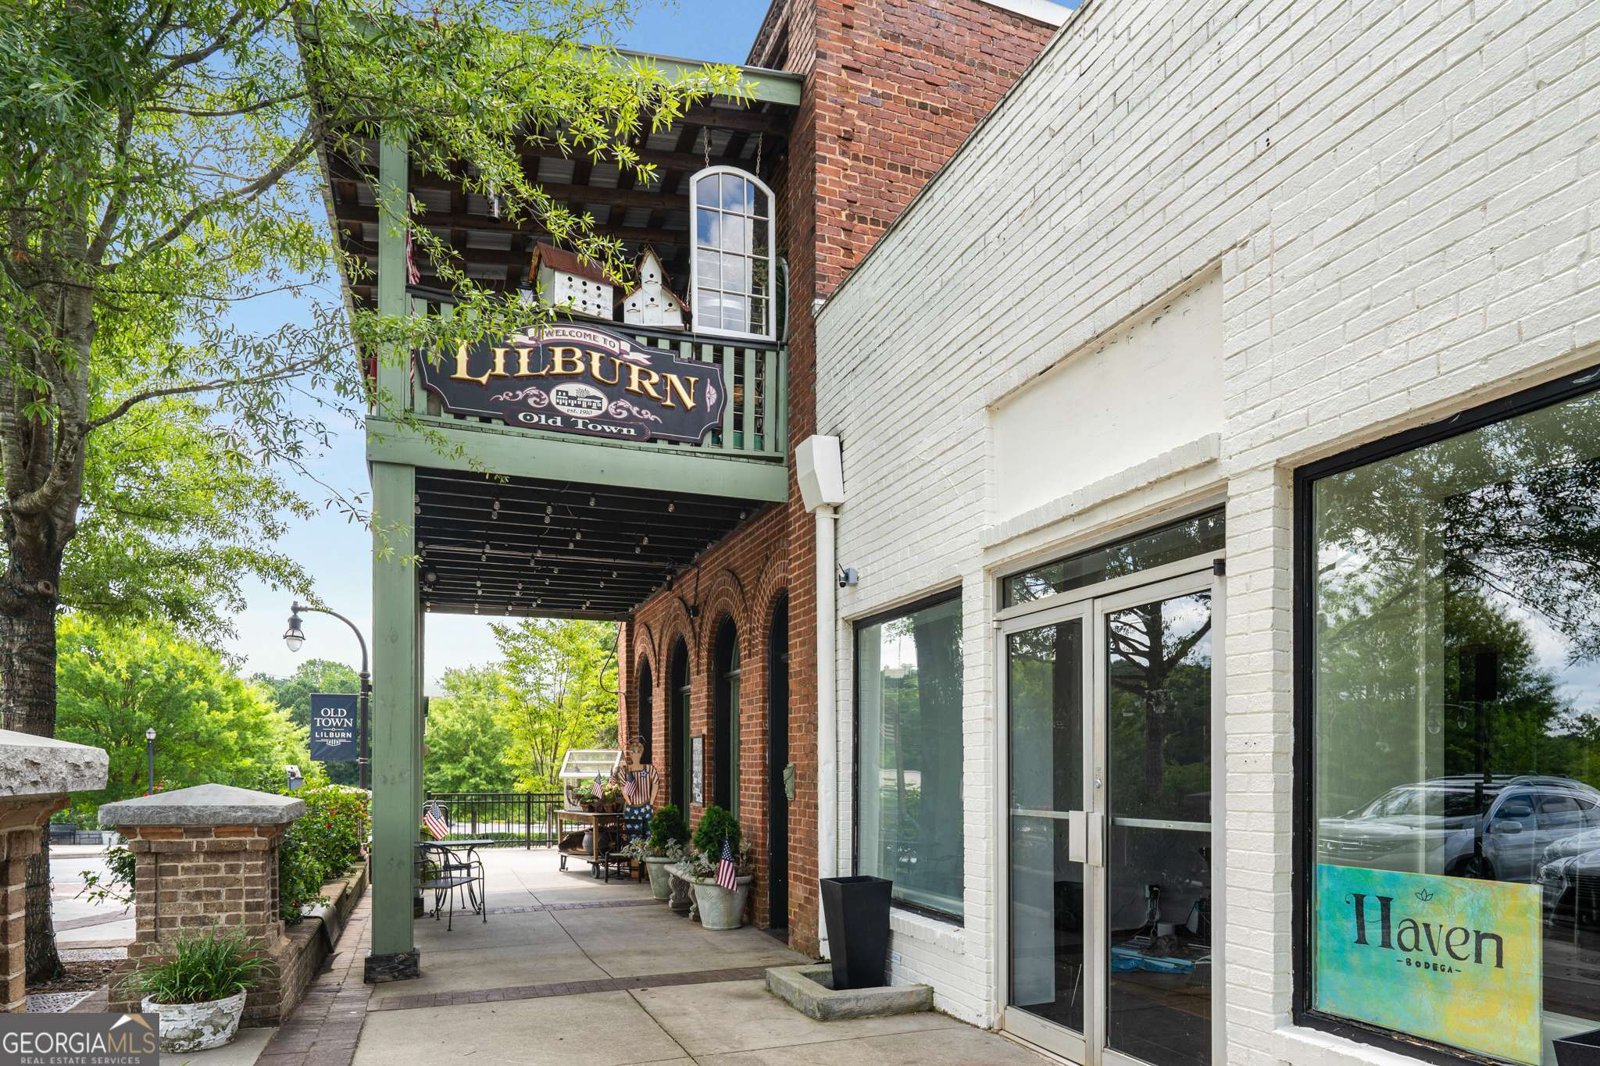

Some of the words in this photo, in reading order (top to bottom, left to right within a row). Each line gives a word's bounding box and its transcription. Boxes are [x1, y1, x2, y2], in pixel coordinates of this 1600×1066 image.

[544, 328, 599, 342] WELCOME
[602, 336, 616, 349] TO
[450, 339, 699, 411] LILBURN
[518, 412, 563, 427] Old
[570, 417, 637, 436] Town
[314, 717, 353, 727] TOWN
[321, 707, 347, 717] OLD
[1345, 893, 1504, 969] Haven
